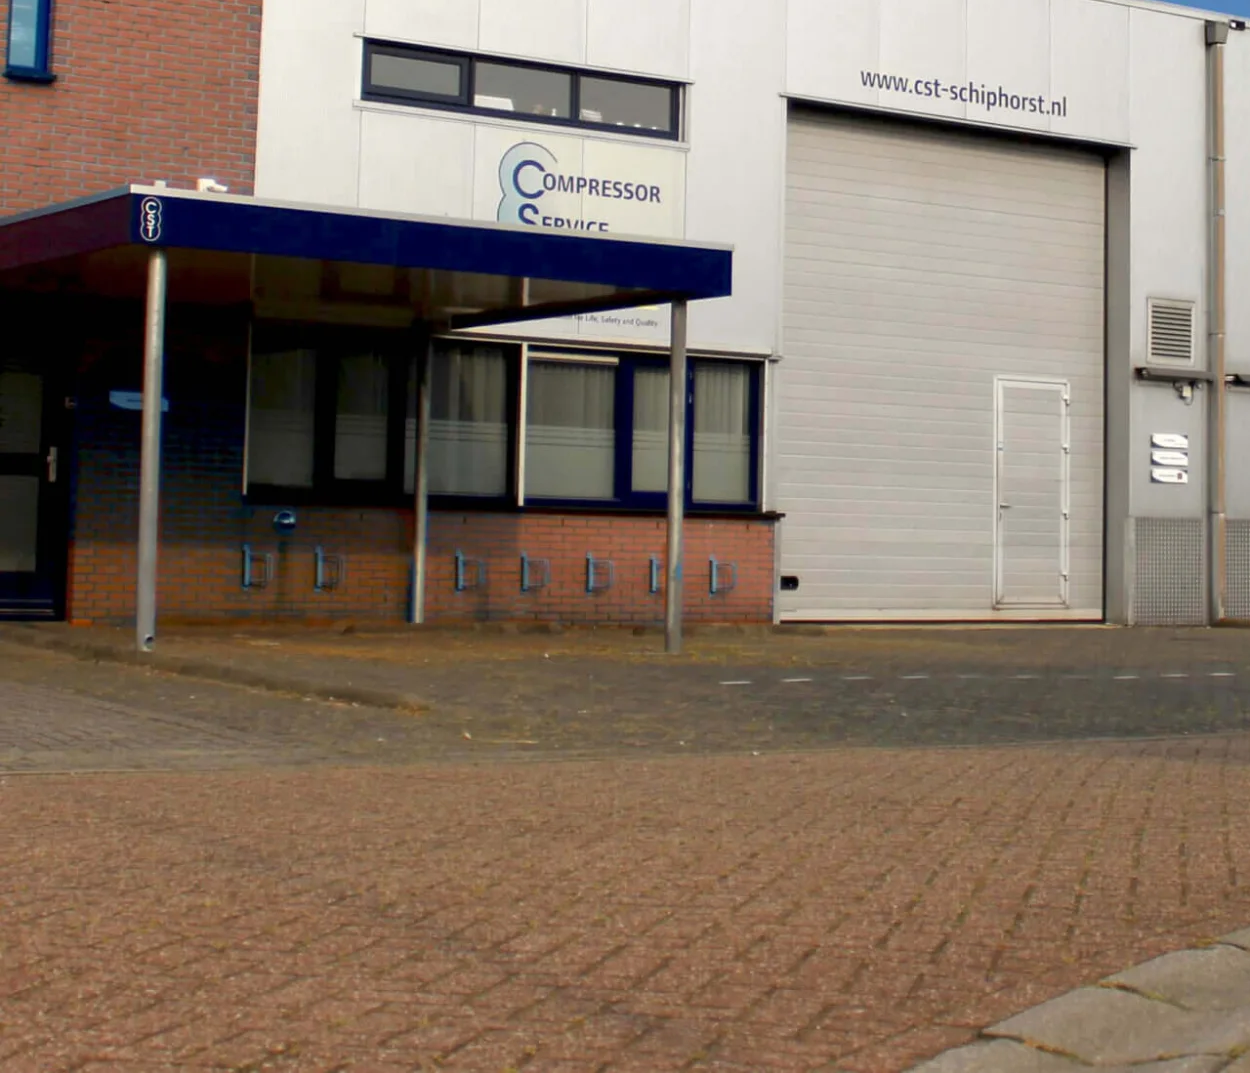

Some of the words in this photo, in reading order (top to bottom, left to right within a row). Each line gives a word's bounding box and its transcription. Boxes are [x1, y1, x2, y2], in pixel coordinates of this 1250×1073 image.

[860, 70, 1067, 117] www.cst-schiphorst.nl
[512, 159, 661, 203] COMPRESSOR
[145, 201, 157, 238] CST
